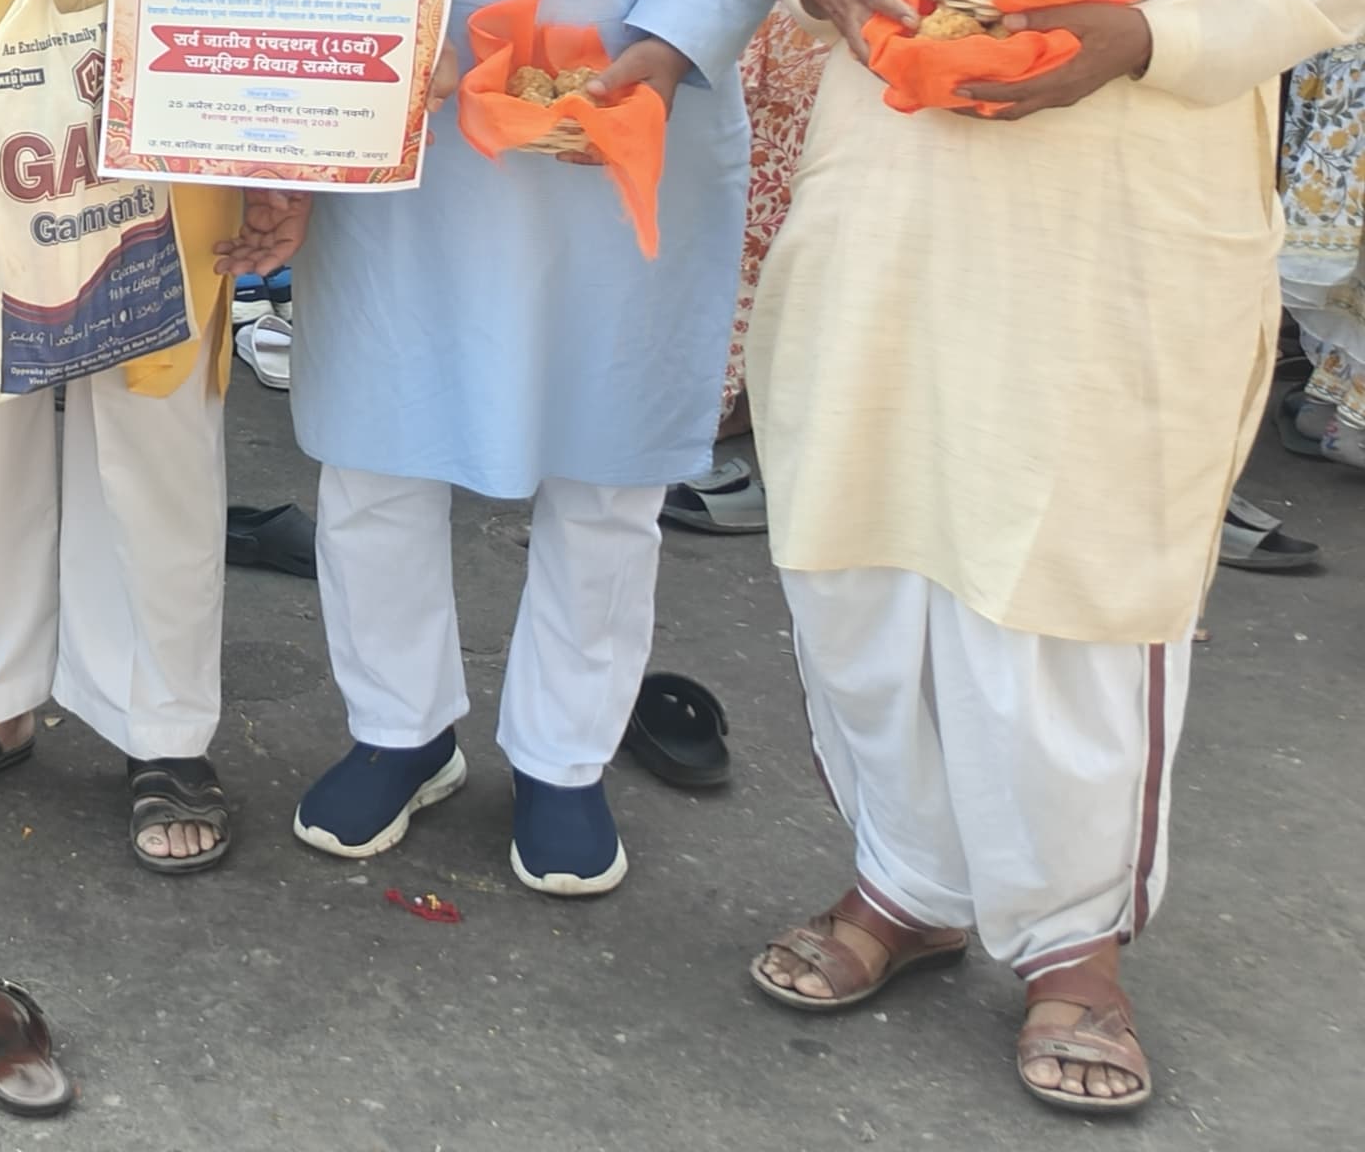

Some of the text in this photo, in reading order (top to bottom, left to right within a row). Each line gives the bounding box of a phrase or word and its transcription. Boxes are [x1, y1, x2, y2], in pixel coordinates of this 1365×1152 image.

[2, 27, 97, 56] An Exclusive Family
[201, 30, 252, 49] जातीय
[182, 53, 367, 76] सामूहिक विवाह सम्मेलन
[0, 115, 117, 204] GA
